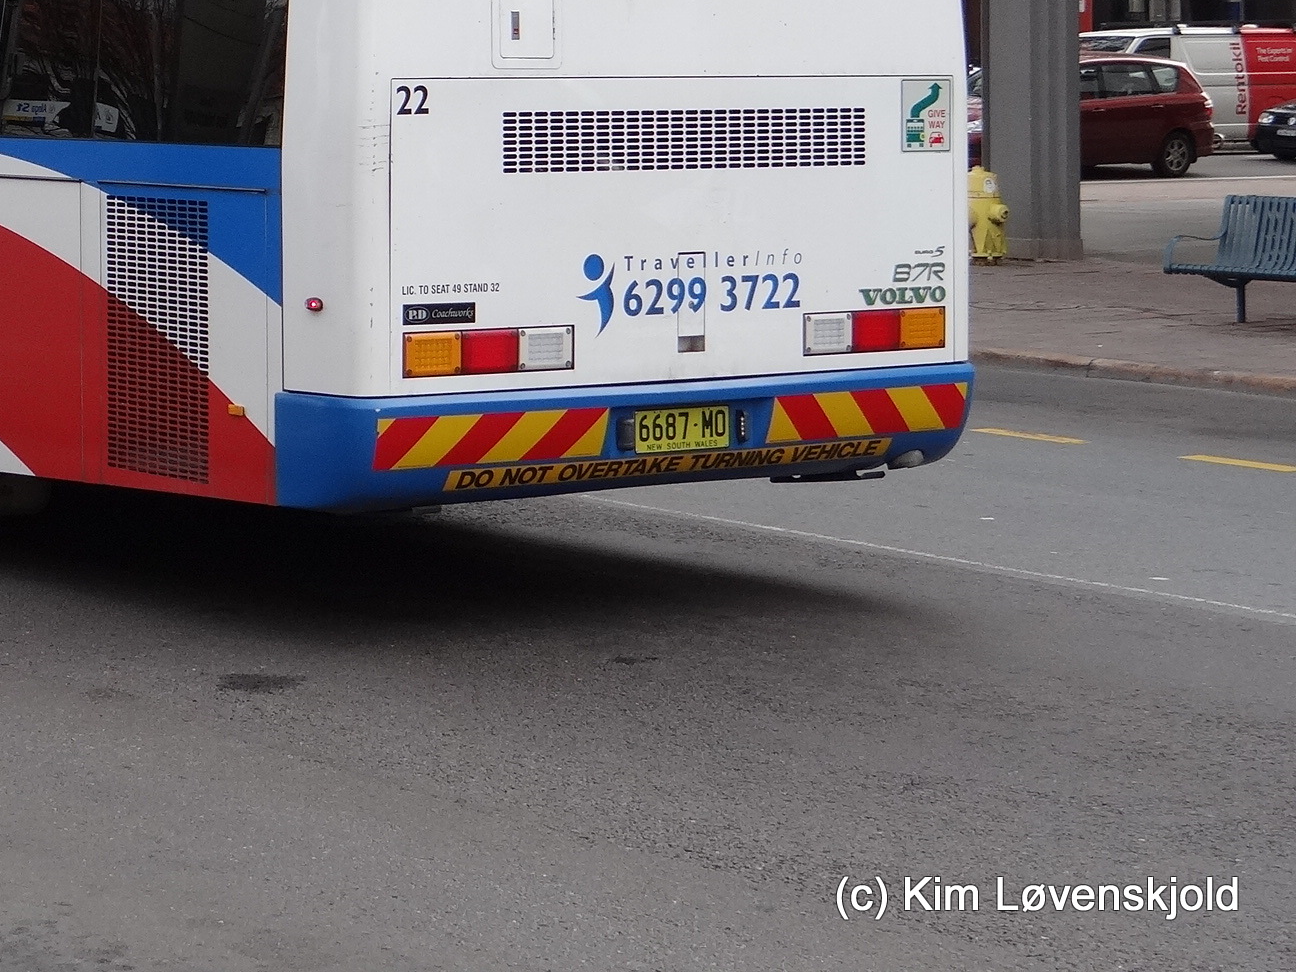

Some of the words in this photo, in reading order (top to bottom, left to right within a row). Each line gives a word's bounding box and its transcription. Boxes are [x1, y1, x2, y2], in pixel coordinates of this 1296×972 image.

[1229, 42, 1247, 115] Rentokil
[396, 85, 429, 115] 22
[927, 109, 946, 118] GIVE
[928, 120, 946, 129] WAY
[892, 262, 946, 282] B7R
[402, 285, 416, 295] LIC.
[419, 285, 429, 295] TO
[431, 284, 450, 294] SEAT
[452, 283, 462, 294] 49
[464, 283, 488, 293] STAND
[490, 282, 500, 292] 32
[623, 277, 707, 317] 6299
[720, 272, 801, 312] 3722
[858, 285, 946, 306] VOLVO
[432, 307, 474, 319] Coachworks
[695, 439, 718, 447] WALES
[455, 470, 494, 490] DO
[499, 466, 554, 486] NOT
[558, 455, 685, 481] OVERTAKE
[690, 449, 784, 470] TURNING
[790, 440, 881, 462] VEHICLE
